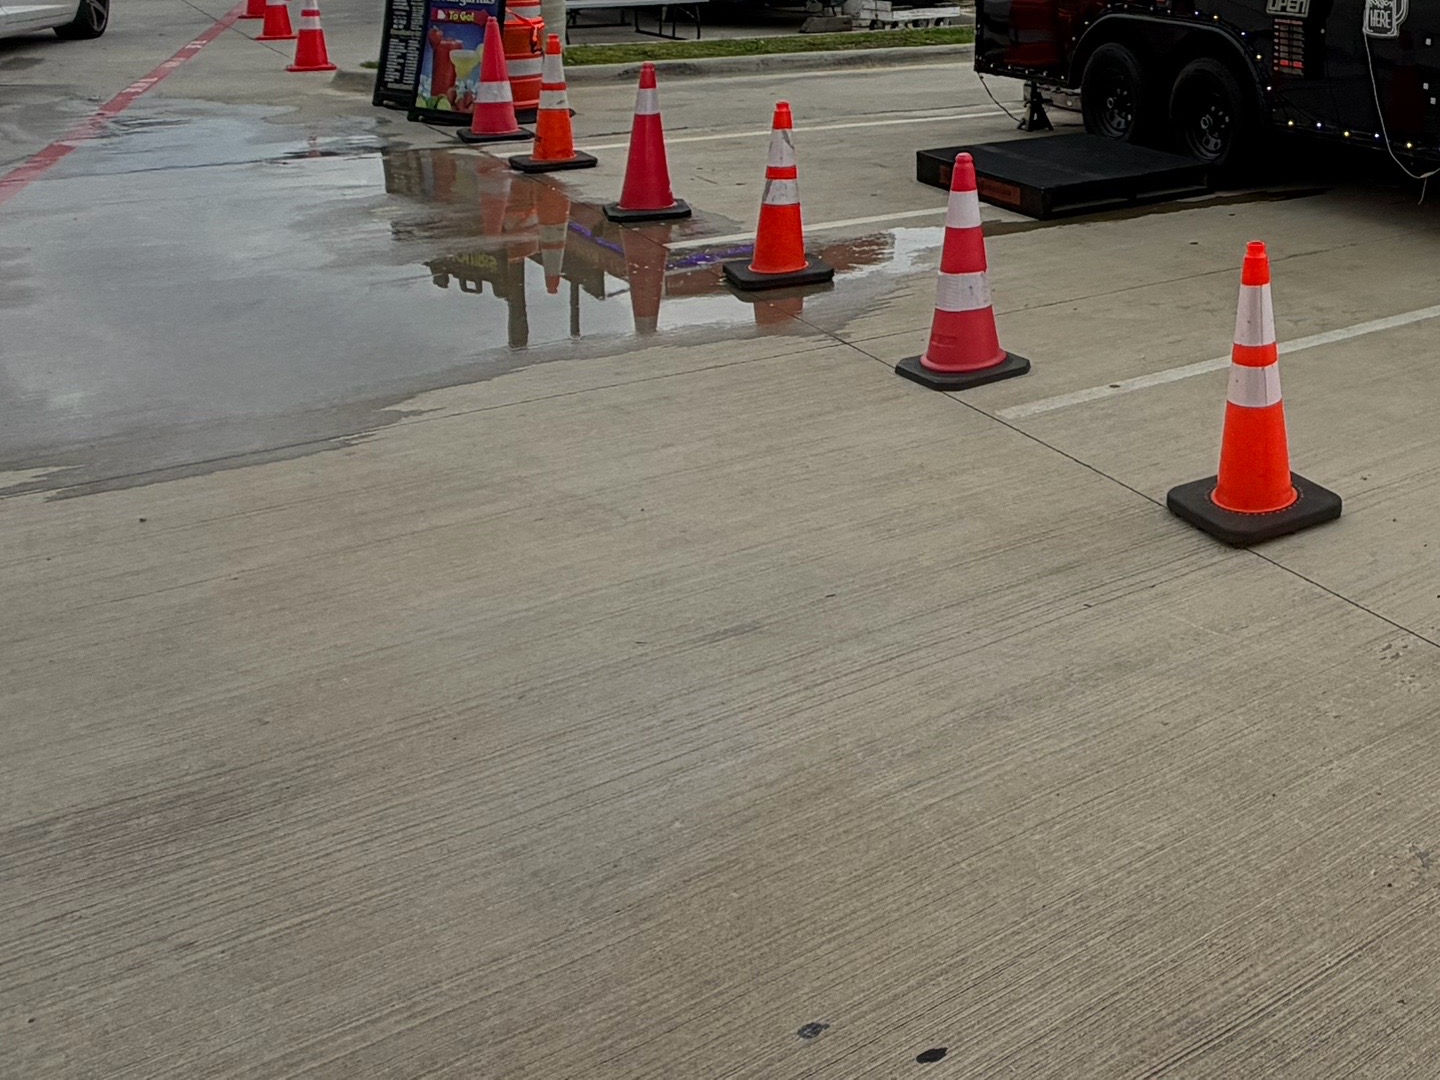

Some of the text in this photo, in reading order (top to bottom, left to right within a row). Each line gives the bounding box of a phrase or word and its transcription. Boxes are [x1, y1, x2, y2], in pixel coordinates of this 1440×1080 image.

[448, 11, 475, 23] To Go!
[1370, 9, 1392, 29] HERE
